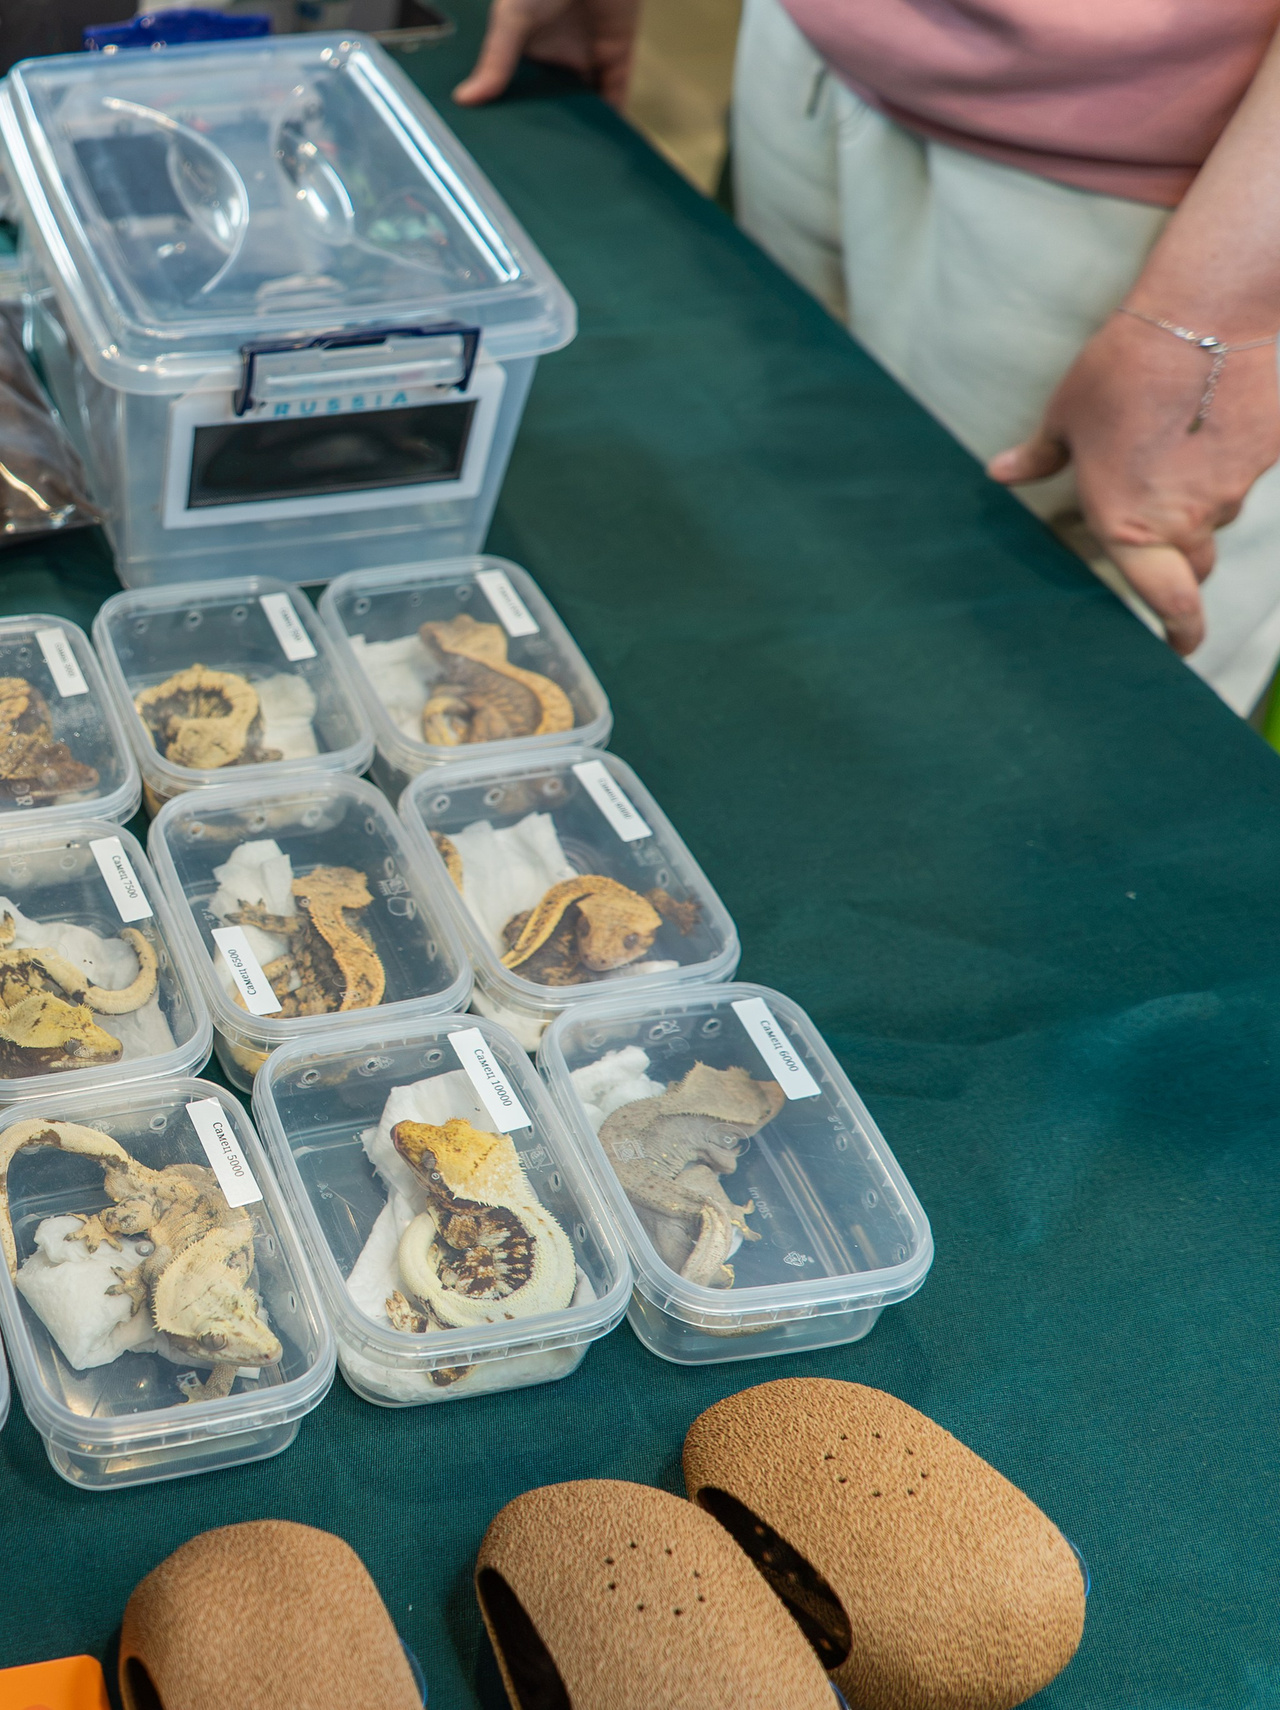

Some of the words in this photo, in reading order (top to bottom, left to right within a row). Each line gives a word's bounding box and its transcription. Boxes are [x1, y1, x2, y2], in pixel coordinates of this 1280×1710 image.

[274, 390, 408, 417] RUSSIA
[112, 855, 128, 880] Самец
[123, 880, 138, 899] 7500
[227, 949, 243, 968] 6500
[239, 968, 257, 995] Самец
[760, 1020, 782, 1050] Самец
[779, 1050, 799, 1072] 6000
[474, 1048, 495, 1080] Самец
[491, 1080, 513, 1107] 10000
[213, 1121, 232, 1155] Самец
[227, 1155, 245, 1177] 5000
